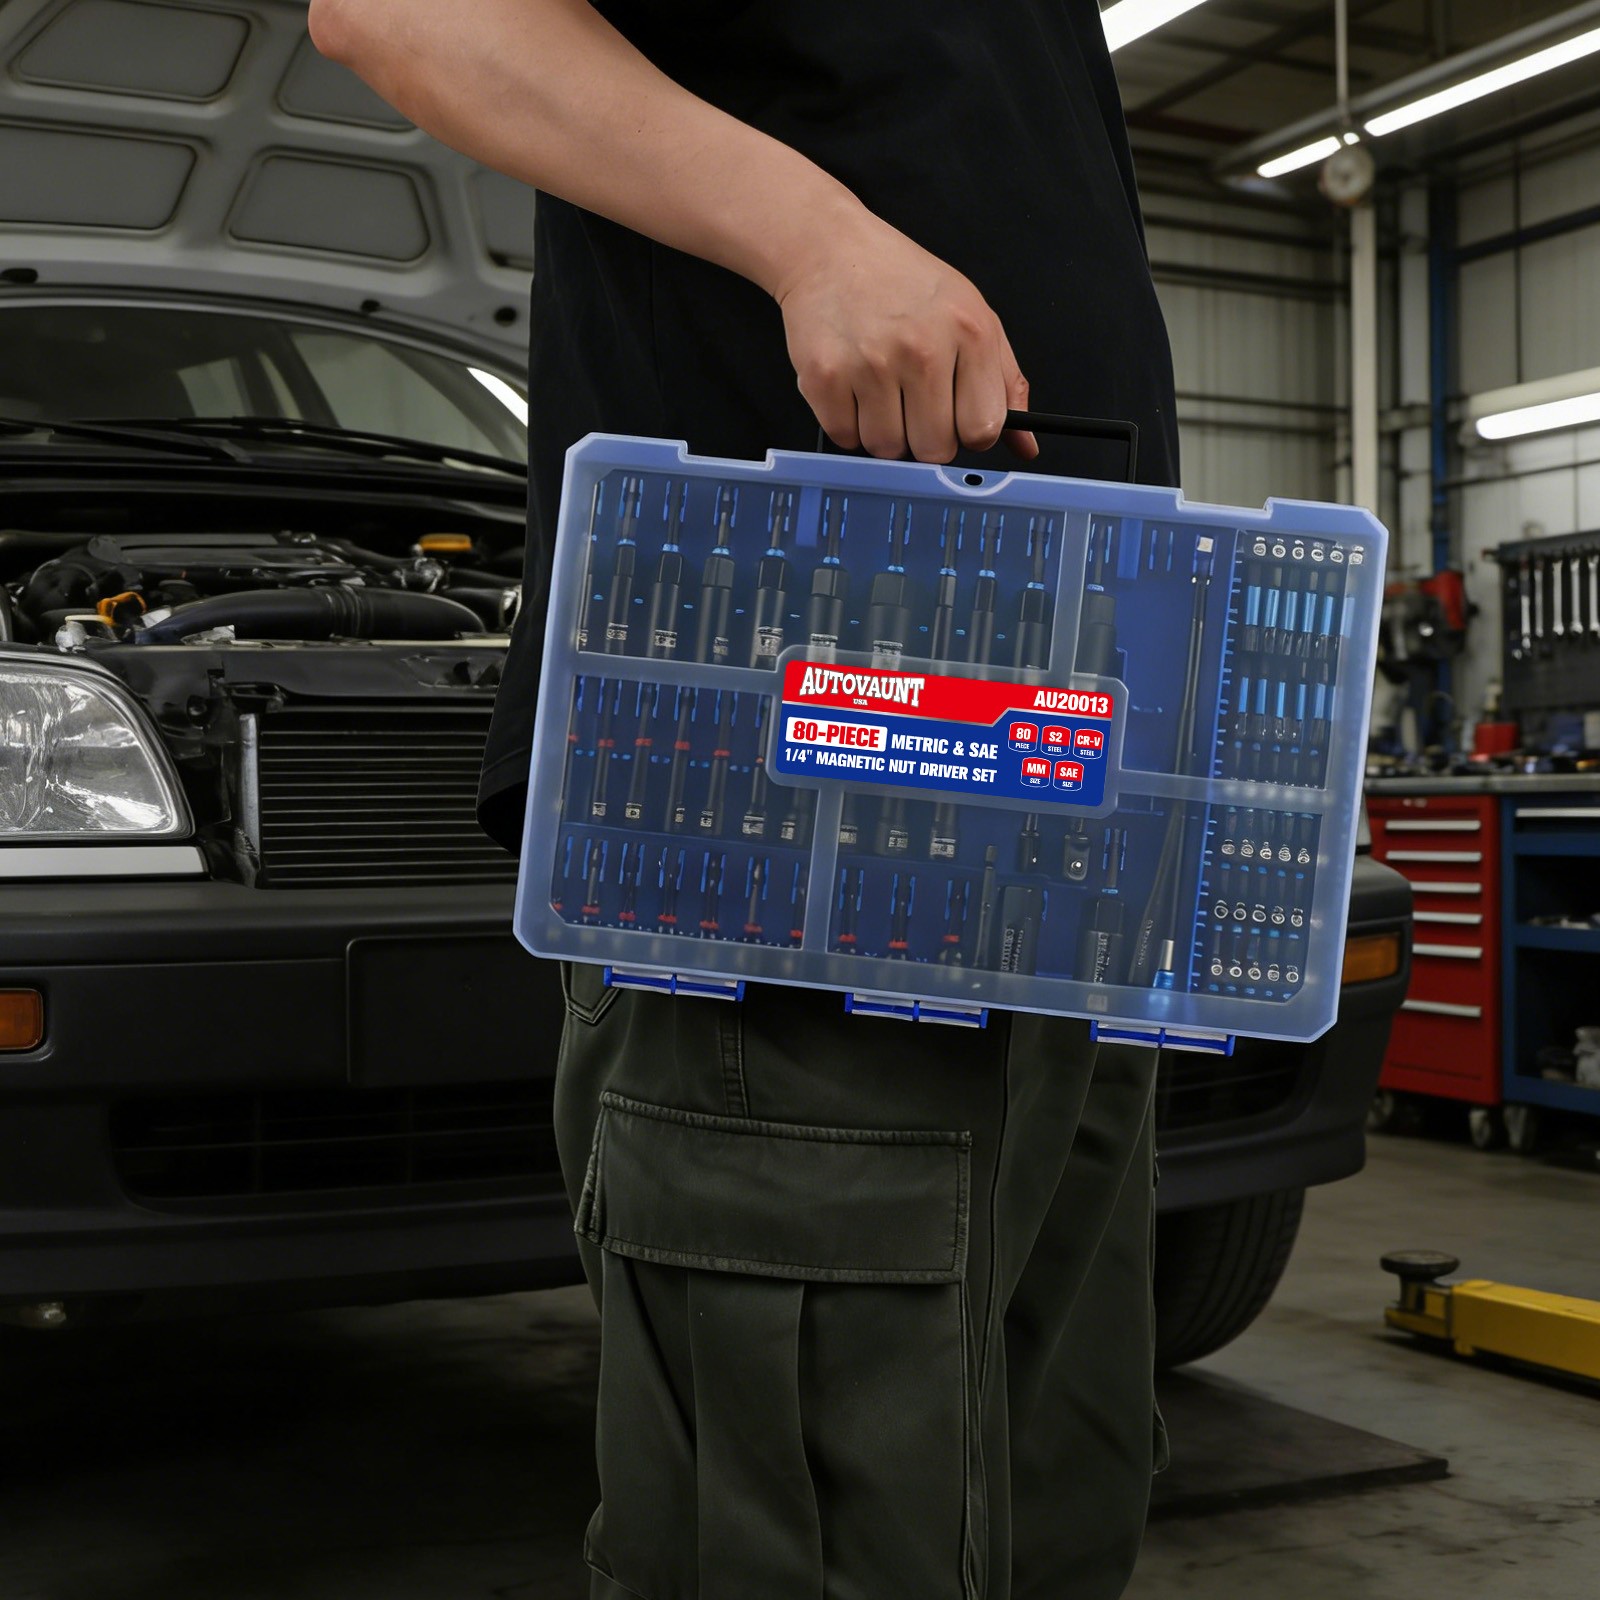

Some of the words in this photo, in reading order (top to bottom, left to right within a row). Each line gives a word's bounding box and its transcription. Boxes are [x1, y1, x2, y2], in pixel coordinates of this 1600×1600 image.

[799, 666, 924, 707] AUTOVAUNT
[853, 698, 867, 706] USA
[1033, 690, 1108, 714] AU20013
[1016, 728, 1031, 740] 80
[1049, 731, 1062, 743] S2
[793, 721, 880, 748] 80-PIECE
[892, 734, 948, 755] METRIC
[953, 740, 964, 756] &
[969, 742, 998, 760] SAE
[1015, 742, 1030, 750] PIECE
[1077, 734, 1100, 747] CR-V
[1080, 749, 1094, 757] STEEL
[785, 748, 813, 763] 1/4"
[816, 751, 885, 772] MAGNETIC
[889, 759, 915, 775] NUT
[920, 762, 968, 780] DRIVER
[972, 767, 997, 783] SET
[1027, 762, 1046, 775] MM
[1060, 766, 1078, 778] SAE
[1030, 777, 1040, 785] SIZE
[1062, 780, 1073, 788] SIZE
